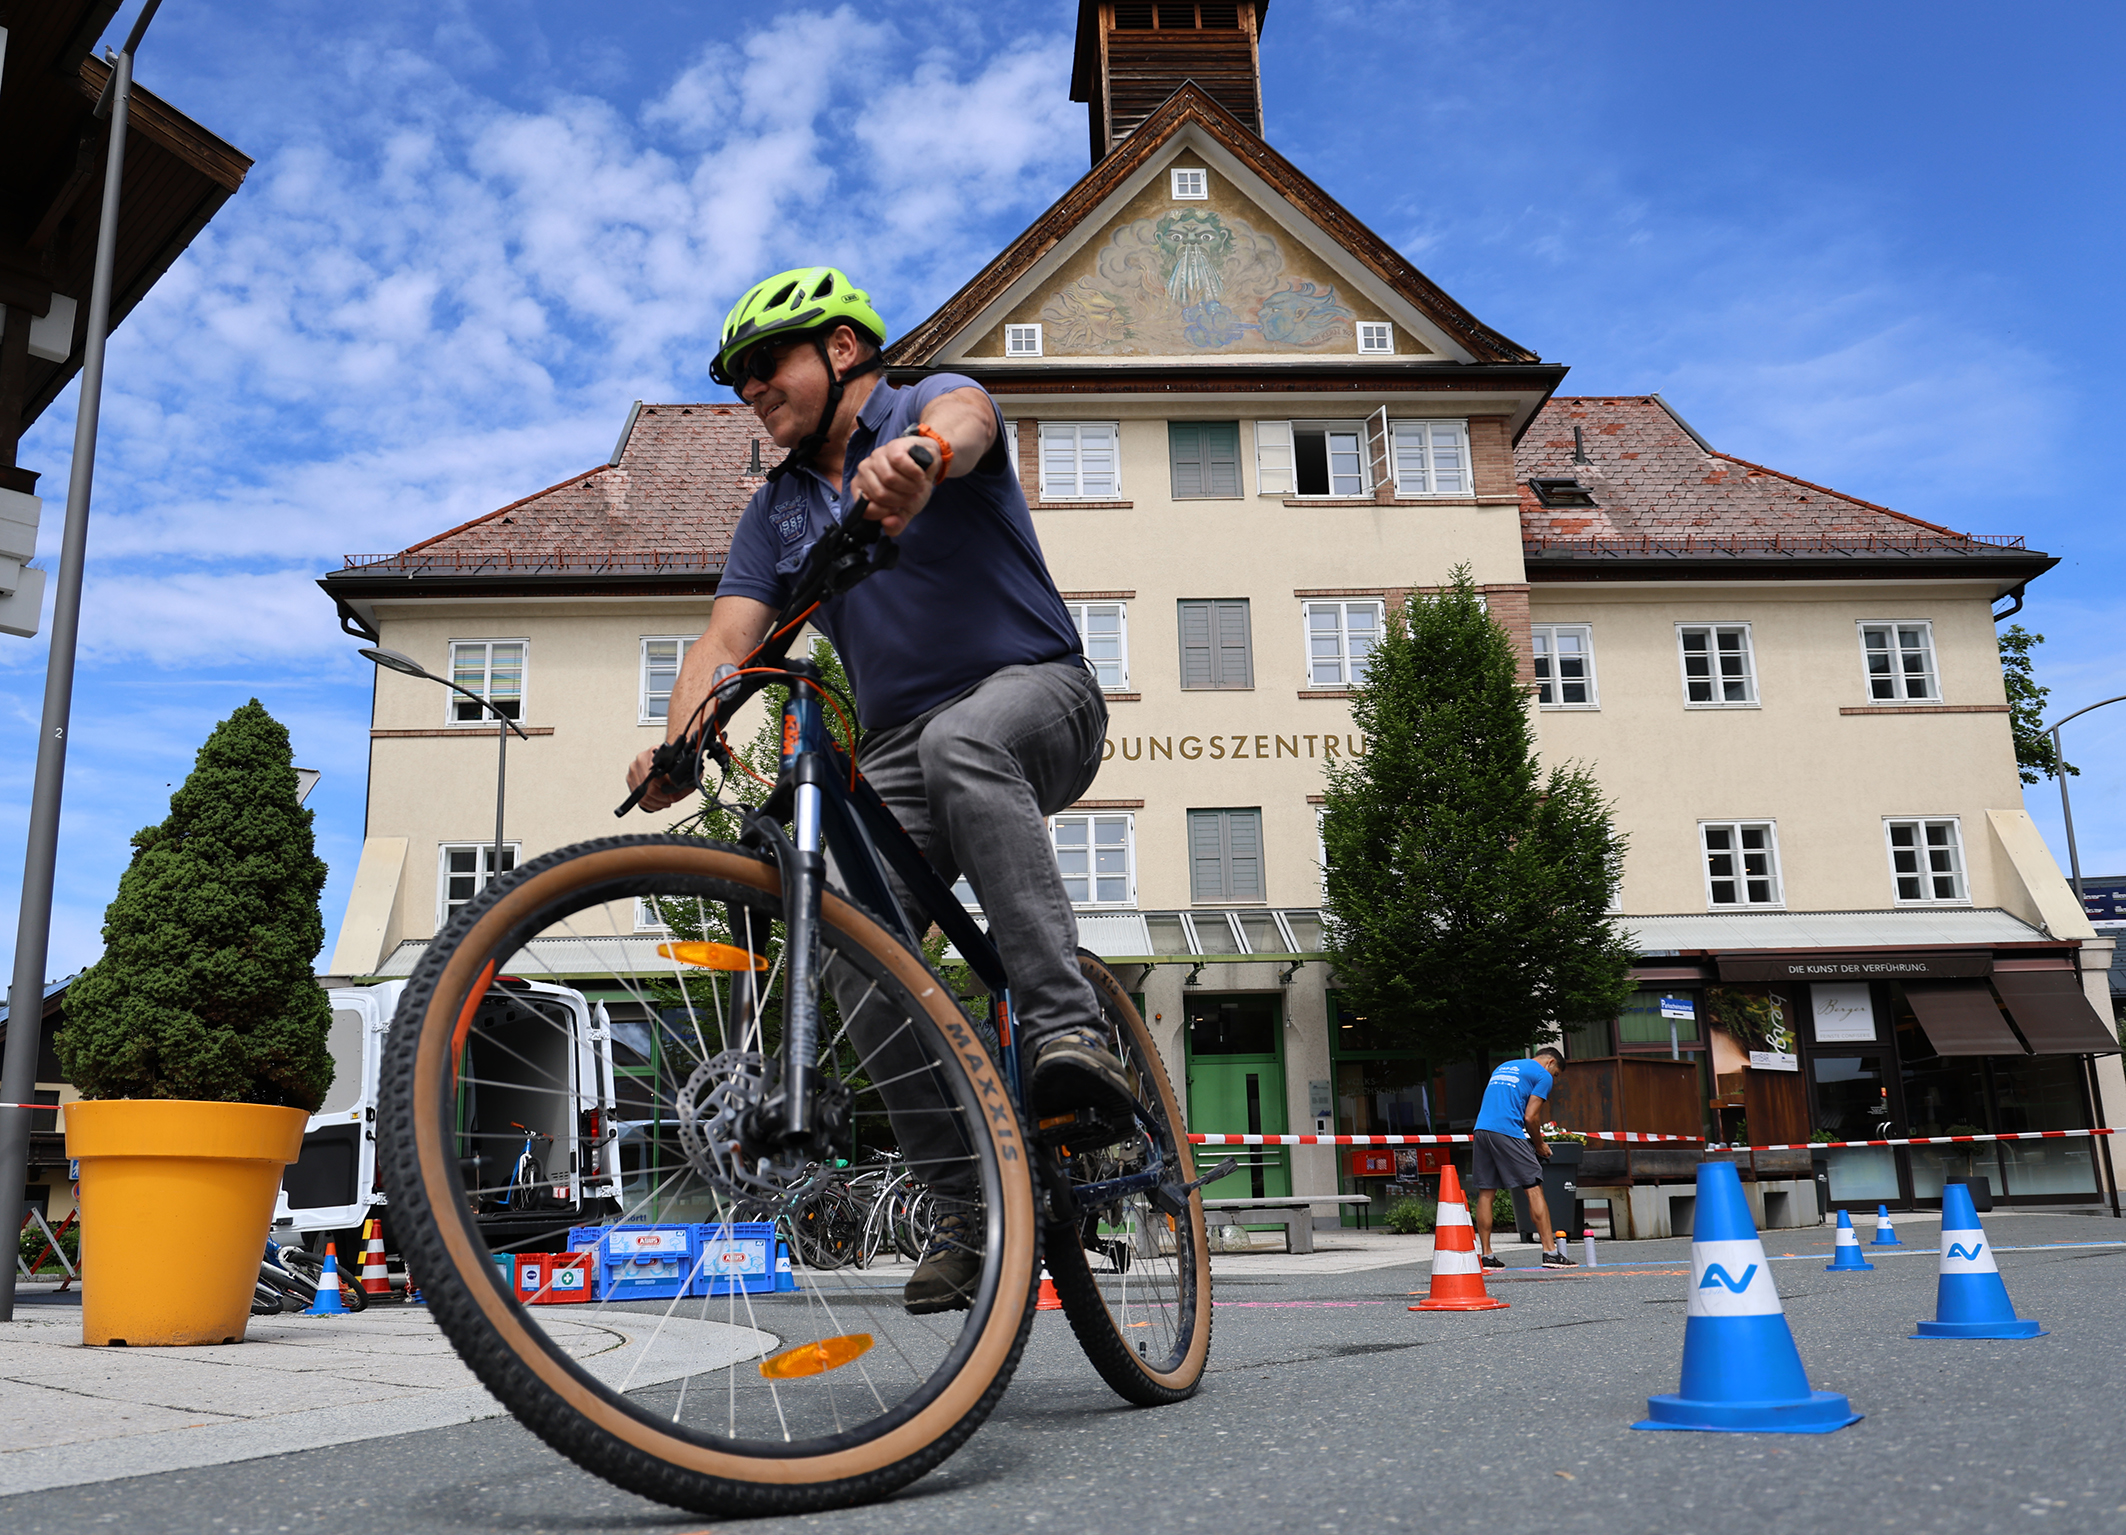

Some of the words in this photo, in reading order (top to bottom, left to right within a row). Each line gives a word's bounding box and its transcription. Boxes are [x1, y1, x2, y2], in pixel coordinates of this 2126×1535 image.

[779, 514, 804, 533] 1985
[55, 727, 63, 739] 2
[782, 714, 799, 753] KTM
[1101, 734, 1367, 761] DUNGSZENTRU
[1080, 963, 1119, 995] MAXXIS
[1788, 965, 1805, 974] DIE
[1807, 964, 1838, 974] KUNST
[1840, 964, 1860, 973] DER
[1862, 962, 1930, 973] VERFÜHRUNG.
[1817, 998, 1867, 1022] Berger
[945, 1023, 1019, 1162] MAXXIS
